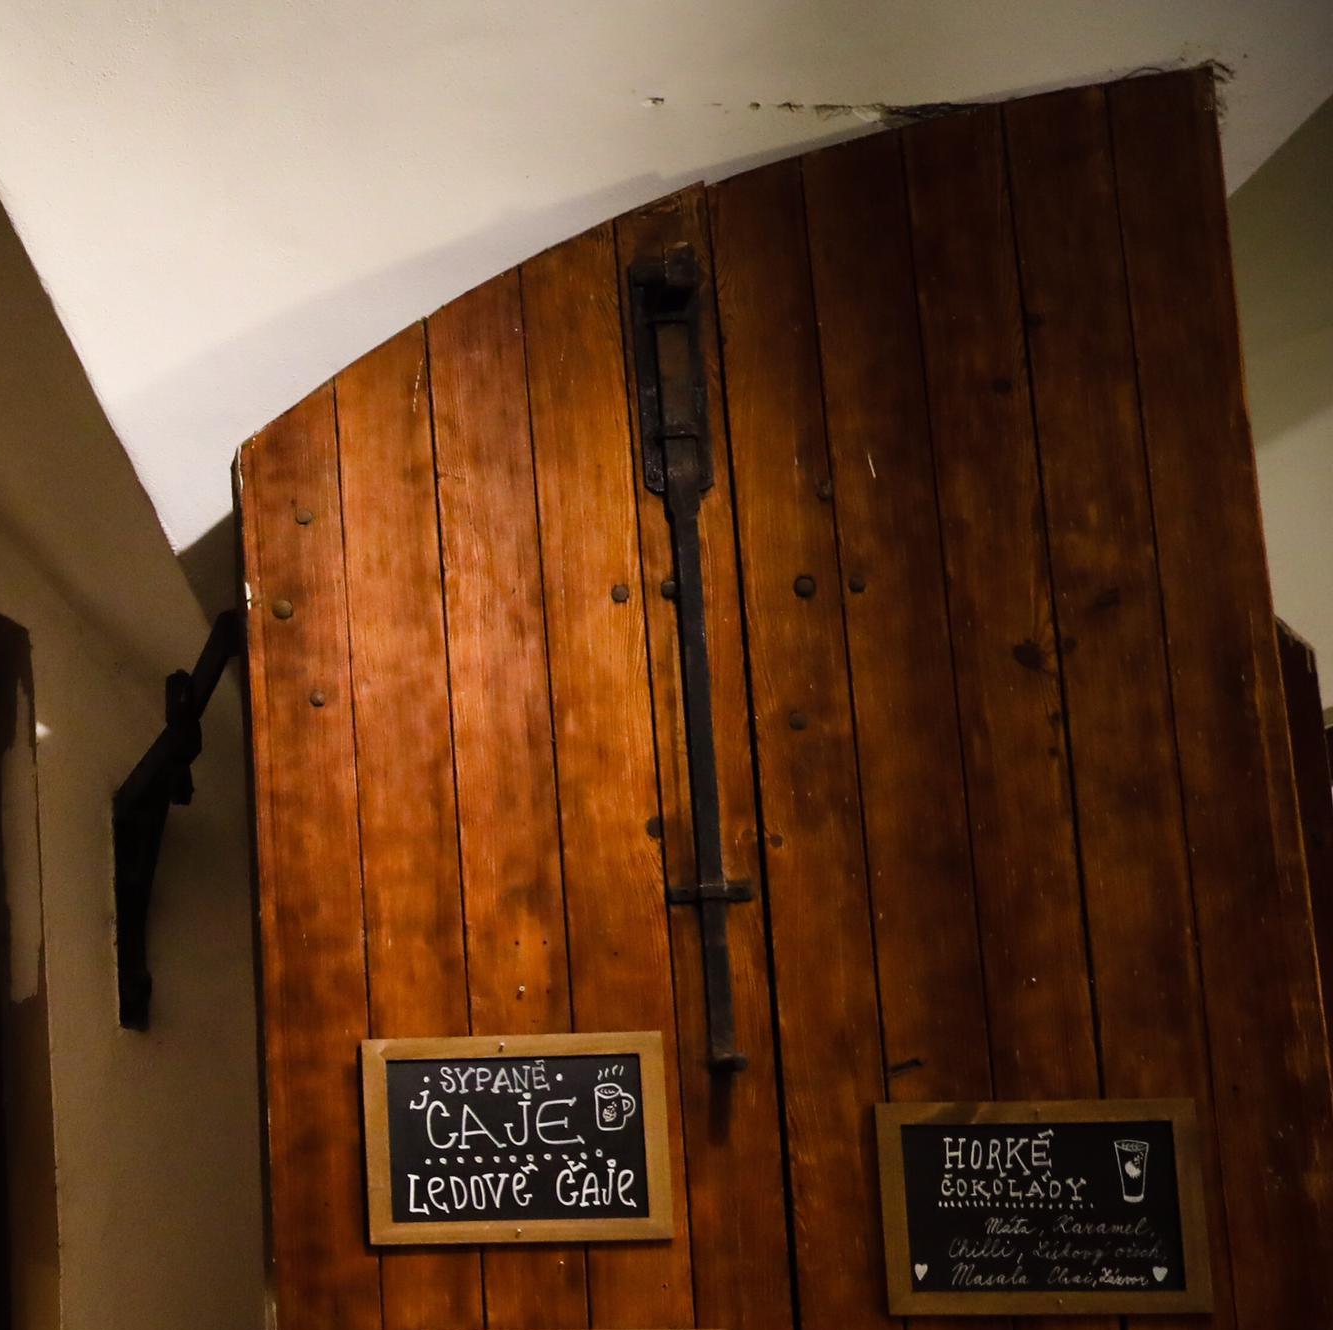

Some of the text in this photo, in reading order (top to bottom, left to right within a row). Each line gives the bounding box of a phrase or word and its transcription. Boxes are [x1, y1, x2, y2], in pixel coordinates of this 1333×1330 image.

[440, 1060, 551, 1095] SYPANÉ
[410, 1090, 586, 1149] ČAJE
[943, 1128, 1054, 1178] HORKÉ
[940, 1170, 1087, 1201] ČOKOLÁDY
